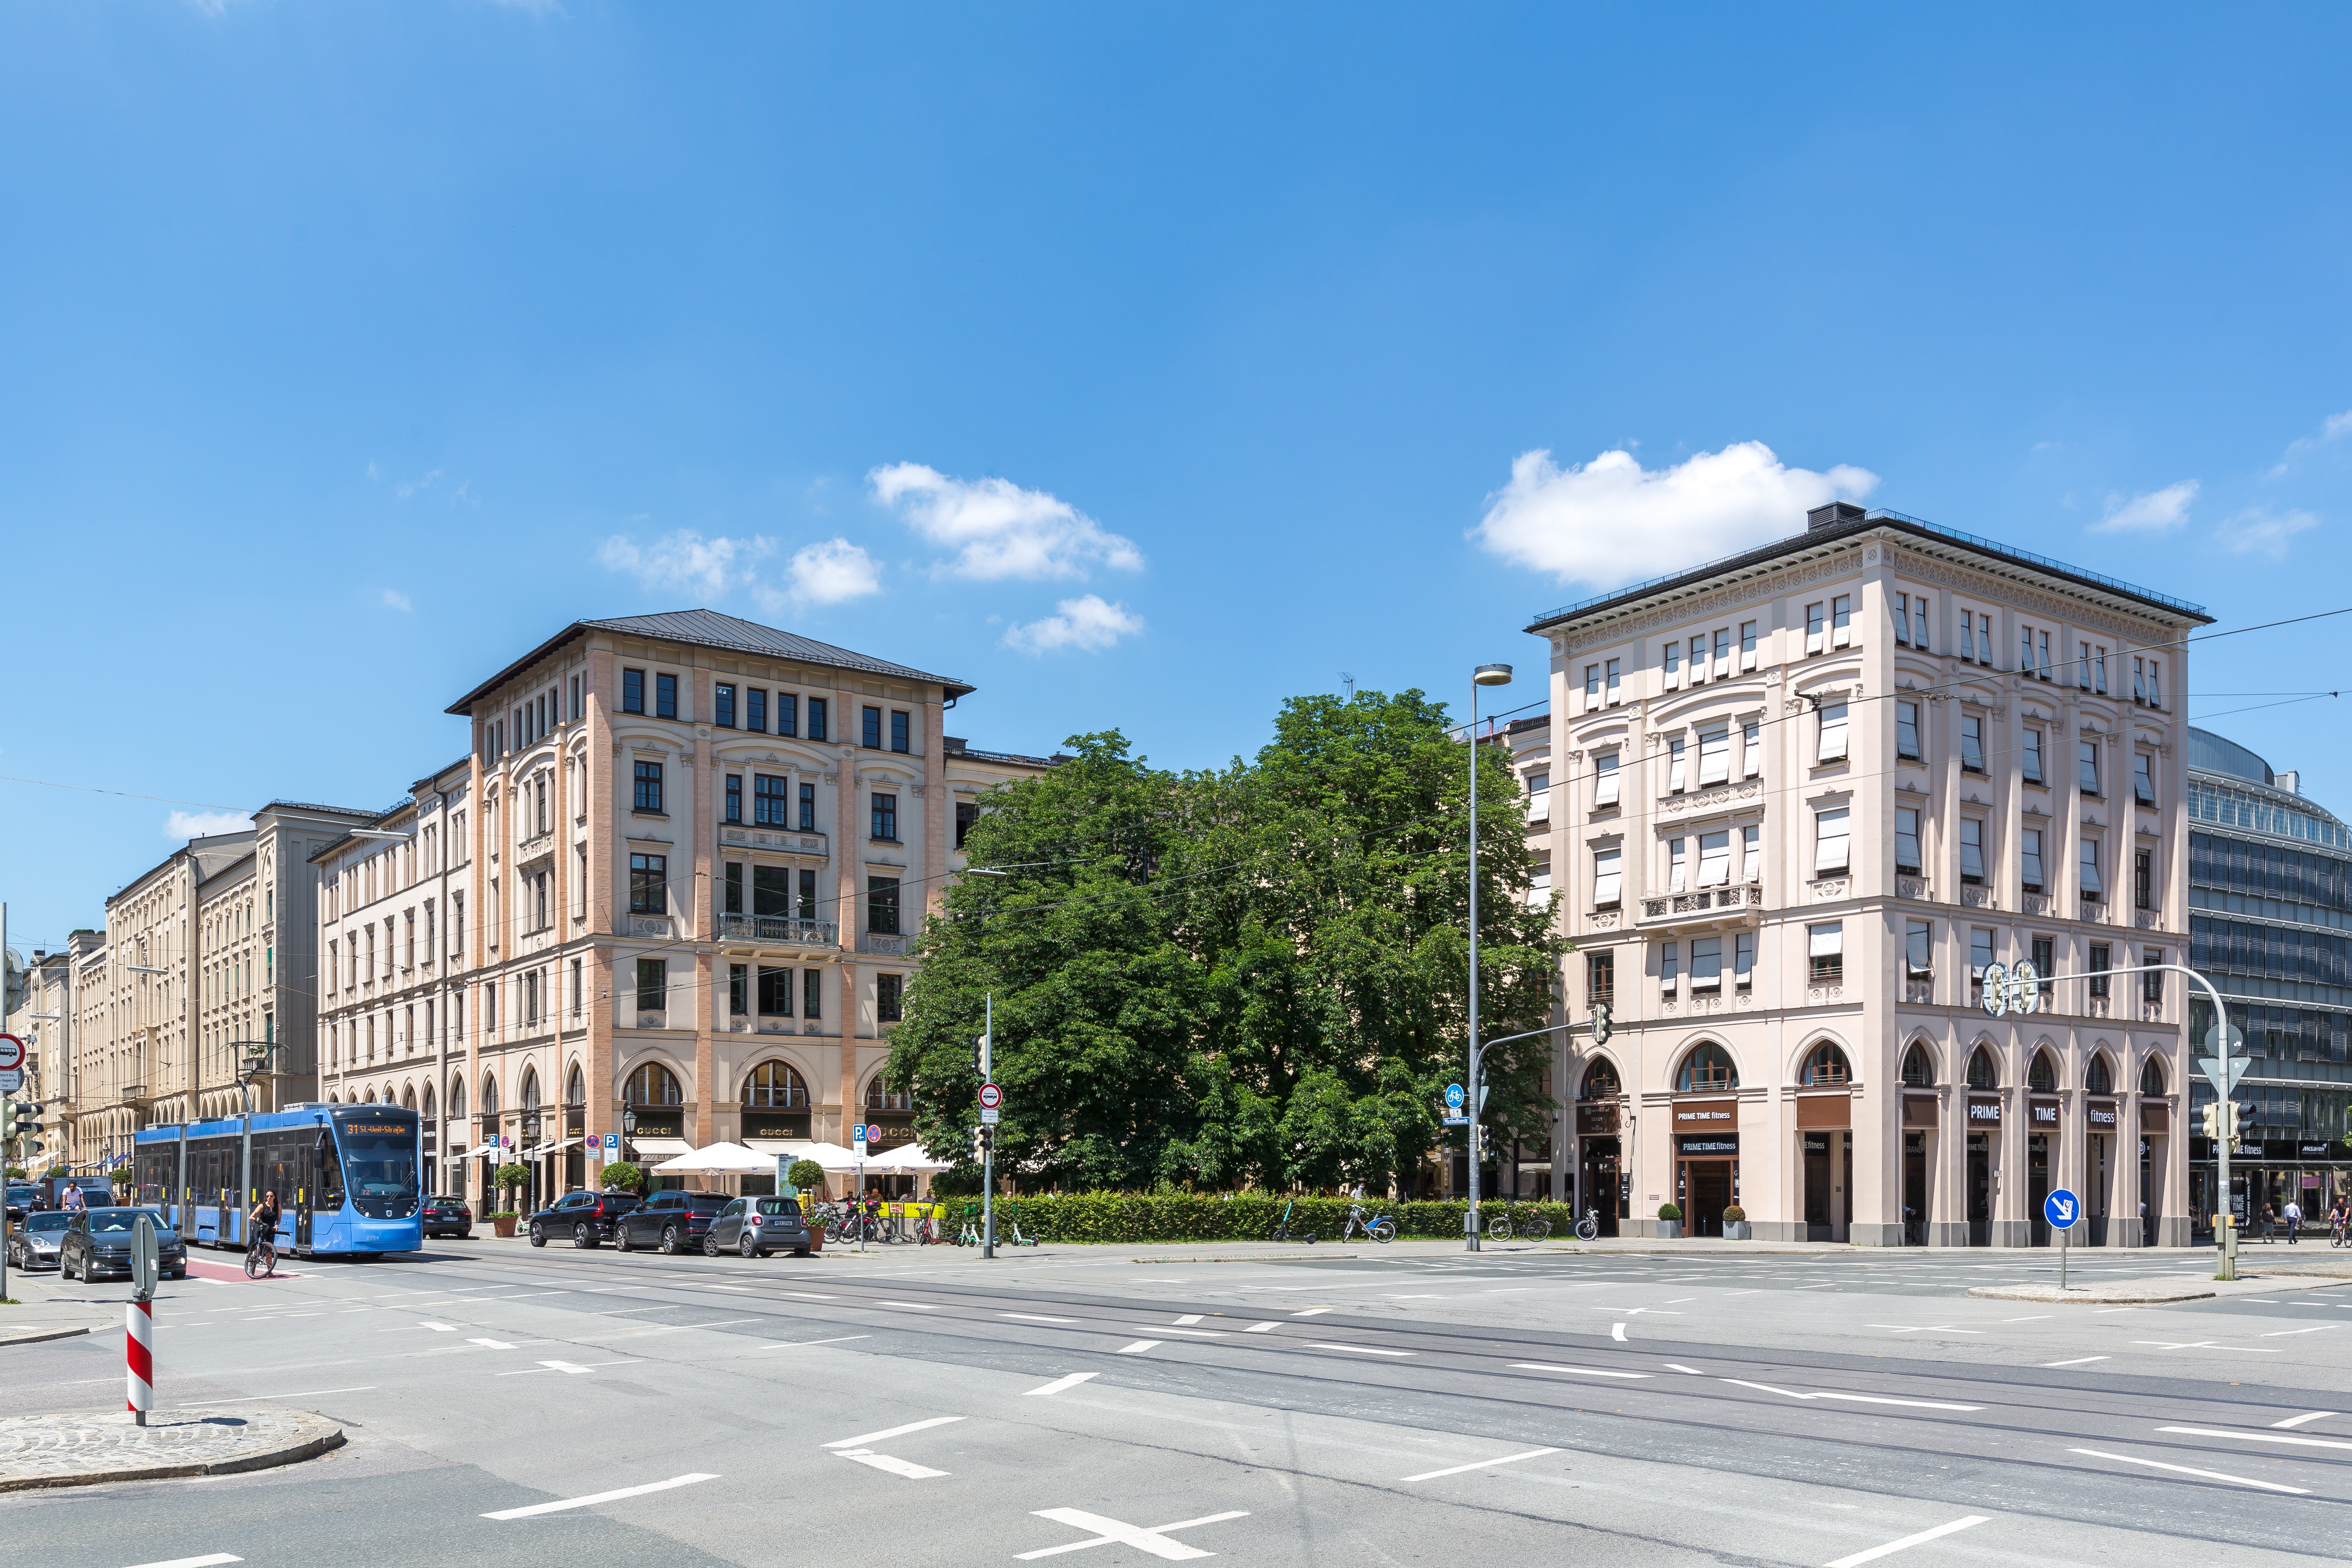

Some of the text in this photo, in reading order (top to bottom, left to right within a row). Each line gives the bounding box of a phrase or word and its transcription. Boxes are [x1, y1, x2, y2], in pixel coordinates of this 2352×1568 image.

[1971, 1105, 2114, 1123] PRIME TIME fitness
[347, 1125, 358, 1134] 31
[880, 1127, 914, 1137] UCCI
[2245, 1145, 2261, 1154] fitness
